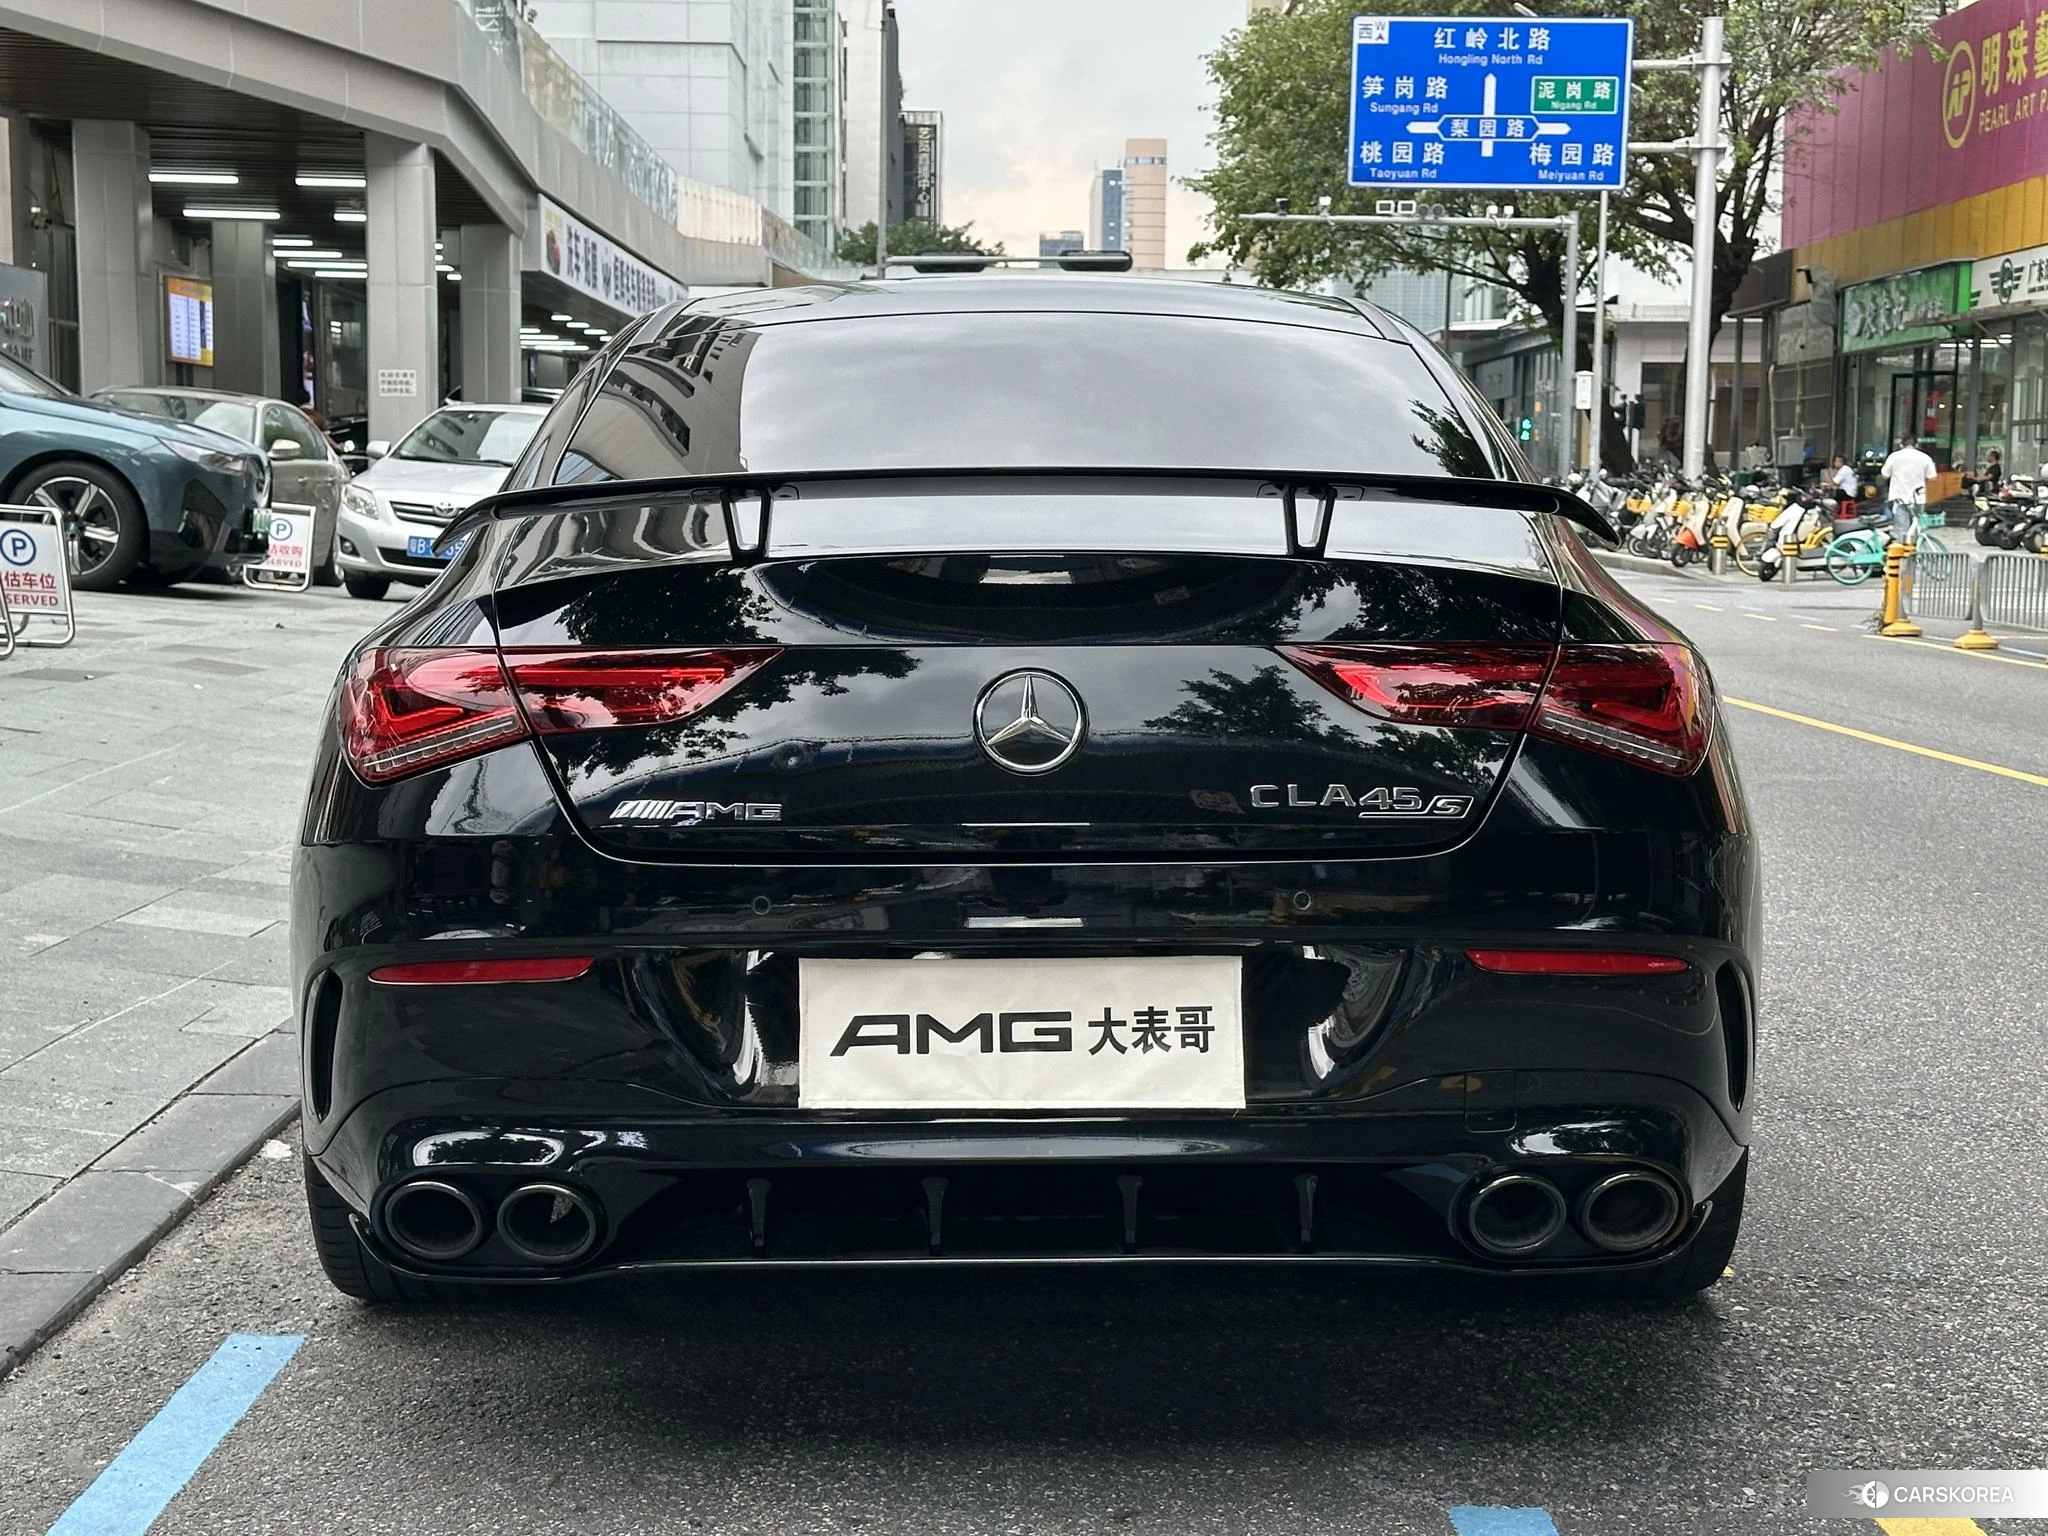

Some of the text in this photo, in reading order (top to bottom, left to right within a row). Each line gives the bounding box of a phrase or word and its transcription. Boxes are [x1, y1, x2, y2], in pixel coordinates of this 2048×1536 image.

[1358, 23, 1373, 39] 西
[1434, 27, 1551, 51] 红岭北路
[1438, 53, 1543, 67] Hongling North Rd
[1362, 75, 1449, 100] 笋岗路
[1538, 81, 1612, 100] 泥岗路
[1370, 102, 1439, 115] Sungang Rd
[1582, 101, 1598, 110] Rd
[1979, 88, 2048, 134] PEARL ART P
[1450, 118, 1526, 138] 梨园路
[1359, 141, 1616, 166] 桃园路 梅园路
[1370, 168, 1437, 180] Taoyuan Rd
[1537, 169, 1605, 182] Meiyuan Rd
[11, 537, 27, 557] P
[4, 571, 57, 590] 估车位
[5, 592, 59, 607] SERVED
[664, 801, 783, 821] AMG
[829, 1006, 1216, 1057] AMG 大表哥
